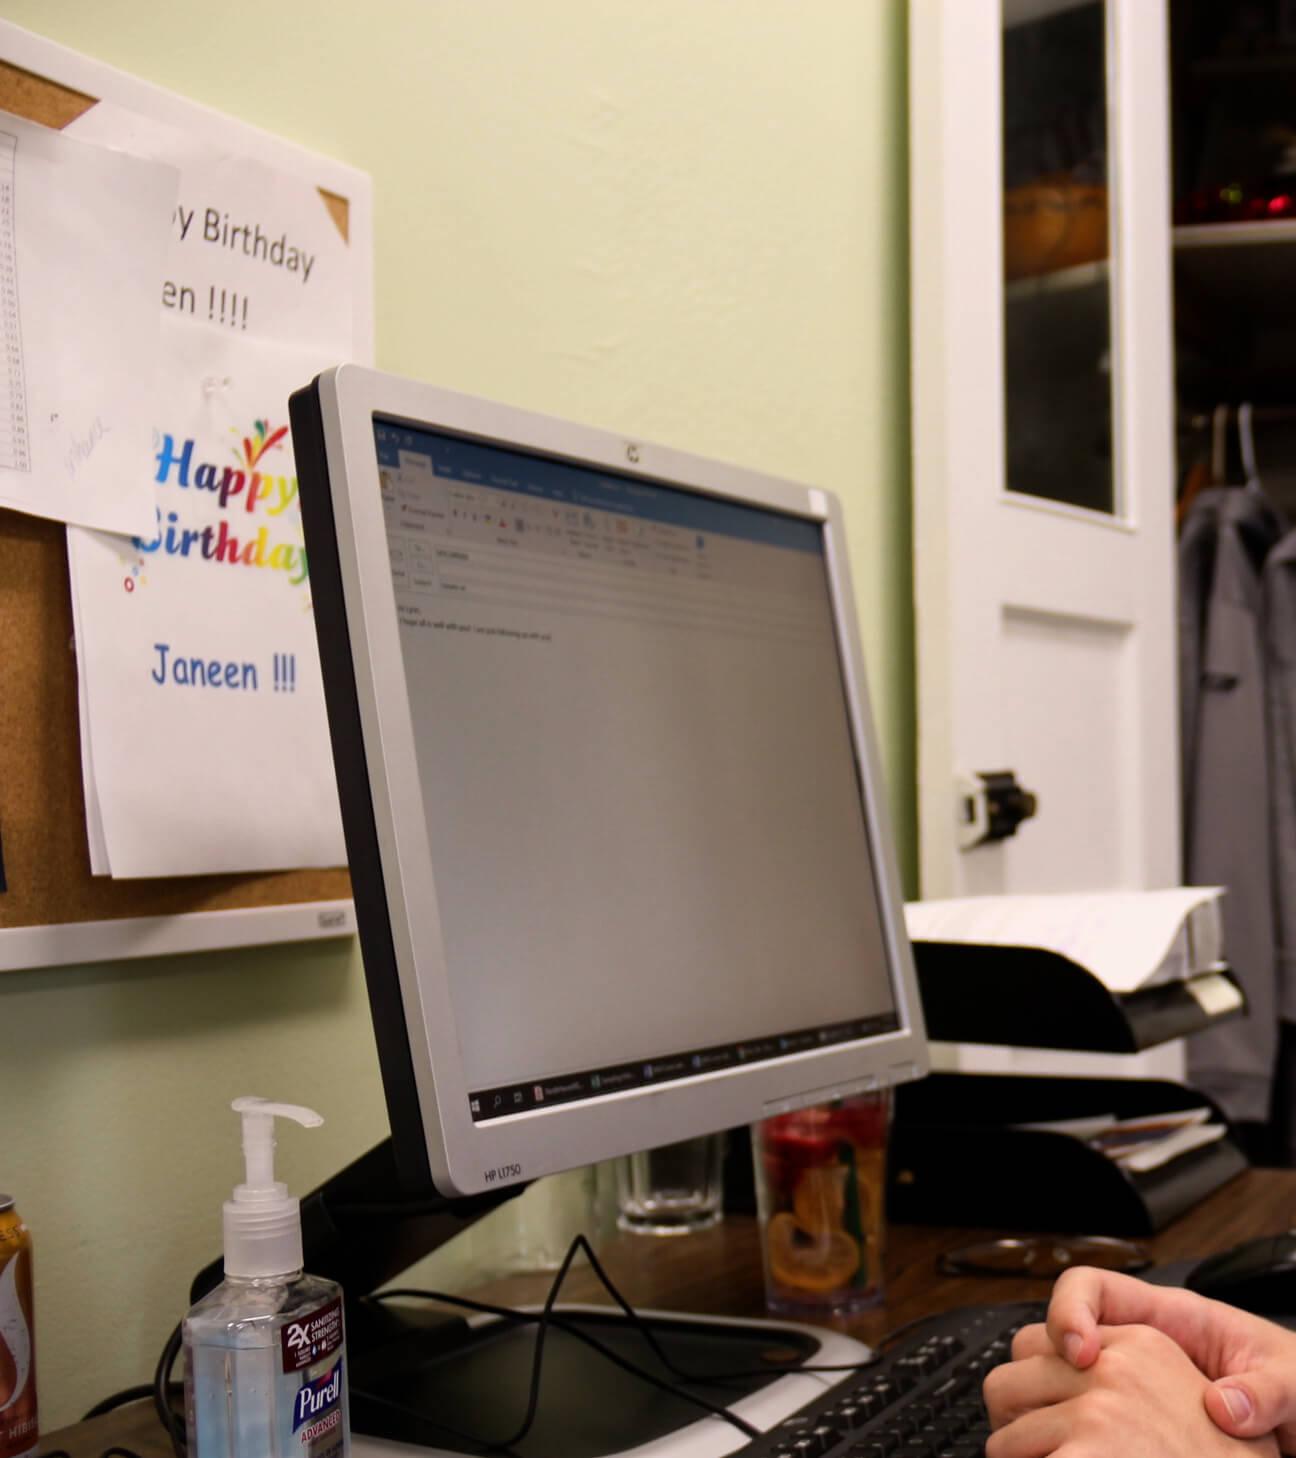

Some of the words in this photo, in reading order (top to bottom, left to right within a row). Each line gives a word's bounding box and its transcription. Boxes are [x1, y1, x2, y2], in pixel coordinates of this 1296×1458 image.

[173, 205, 194, 241] y
[203, 208, 315, 283] Birthday
[162, 281, 195, 314] en
[208, 286, 249, 329] !!!!
[155, 434, 299, 516] Happy
[151, 644, 258, 691] Janeen
[272, 654, 297, 692] !!!
[484, 1168, 497, 1183] HP
[287, 1323, 311, 1349] 2X
[300, 1369, 339, 1418] Purell
[301, 1409, 342, 1444] ADVANCED
